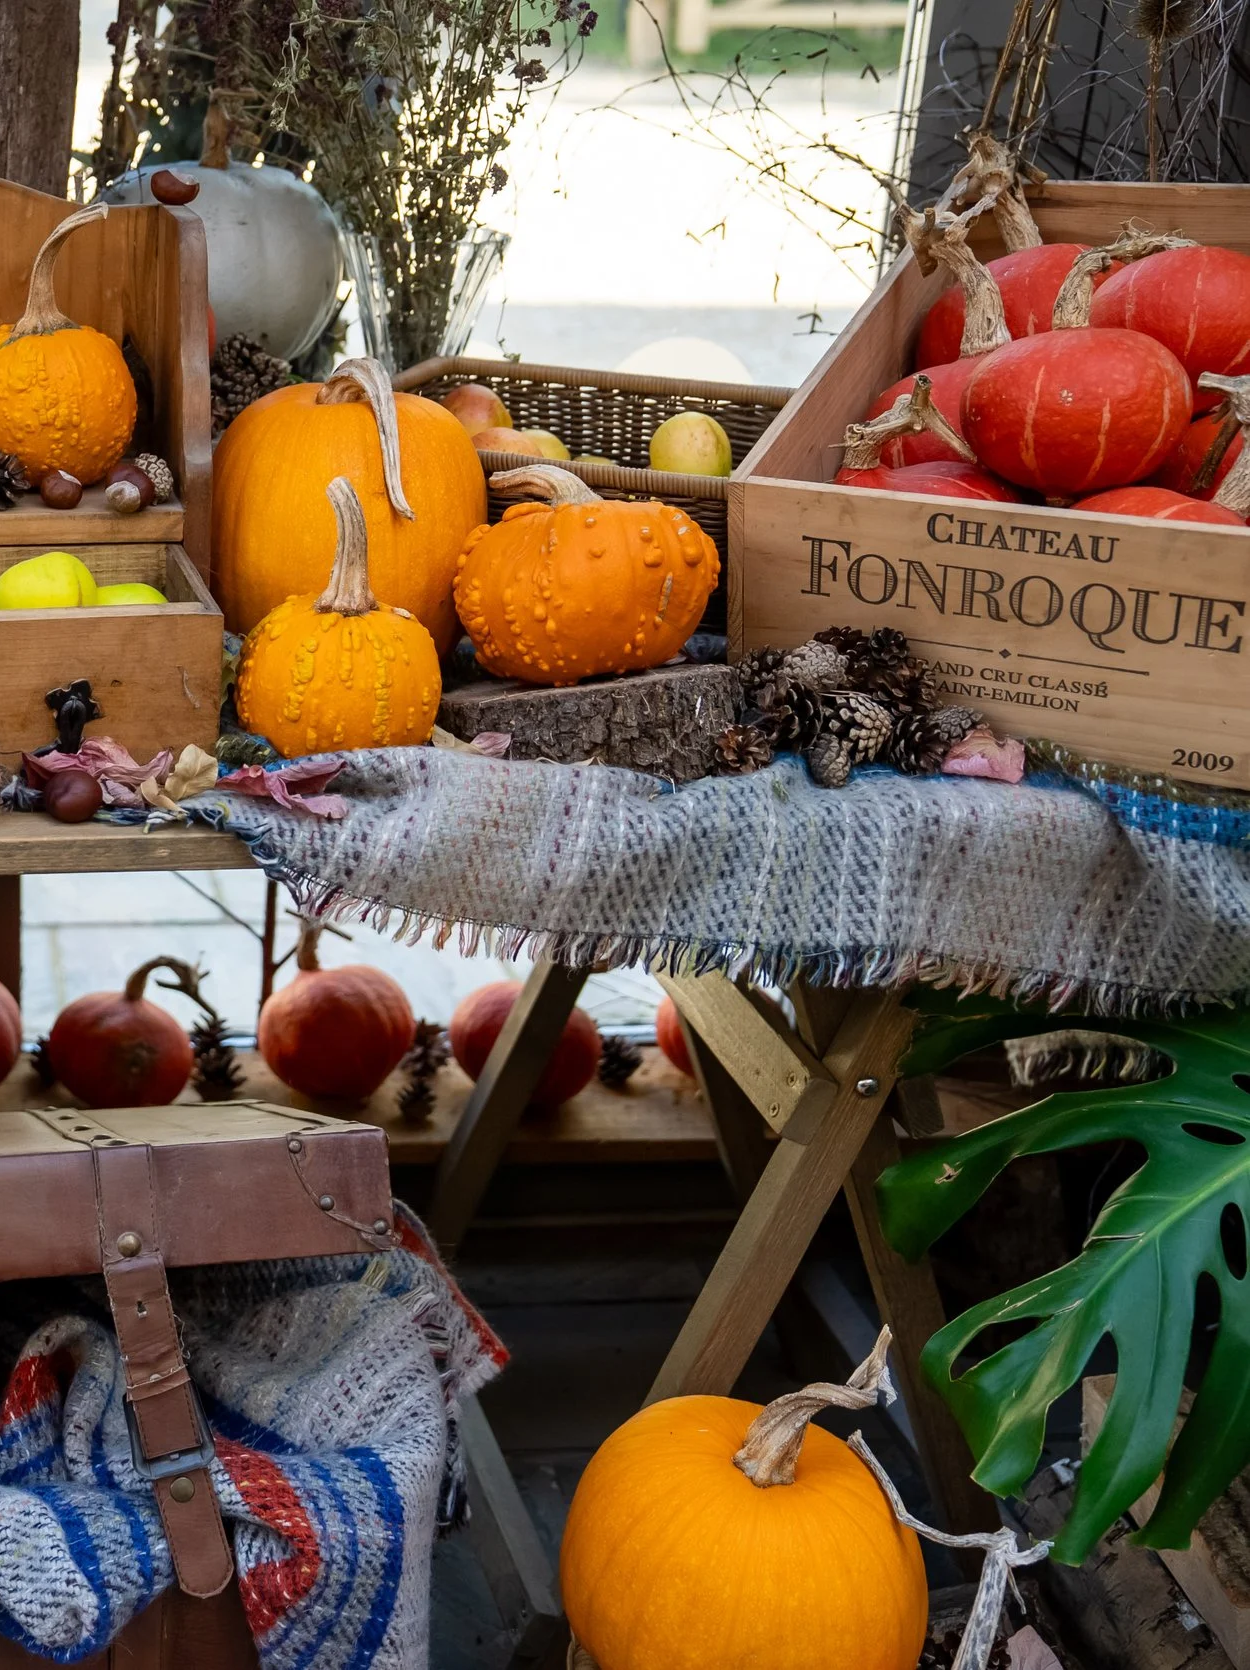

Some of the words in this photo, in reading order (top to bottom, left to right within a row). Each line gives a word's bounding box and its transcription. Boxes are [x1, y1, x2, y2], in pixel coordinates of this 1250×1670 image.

[927, 512, 1120, 564] CHATEAU
[801, 534, 1248, 654] FONROQUE
[980, 667, 1023, 684] CRU
[1028, 673, 1109, 699] CLASSÉ
[1172, 749, 1235, 773] 2009
